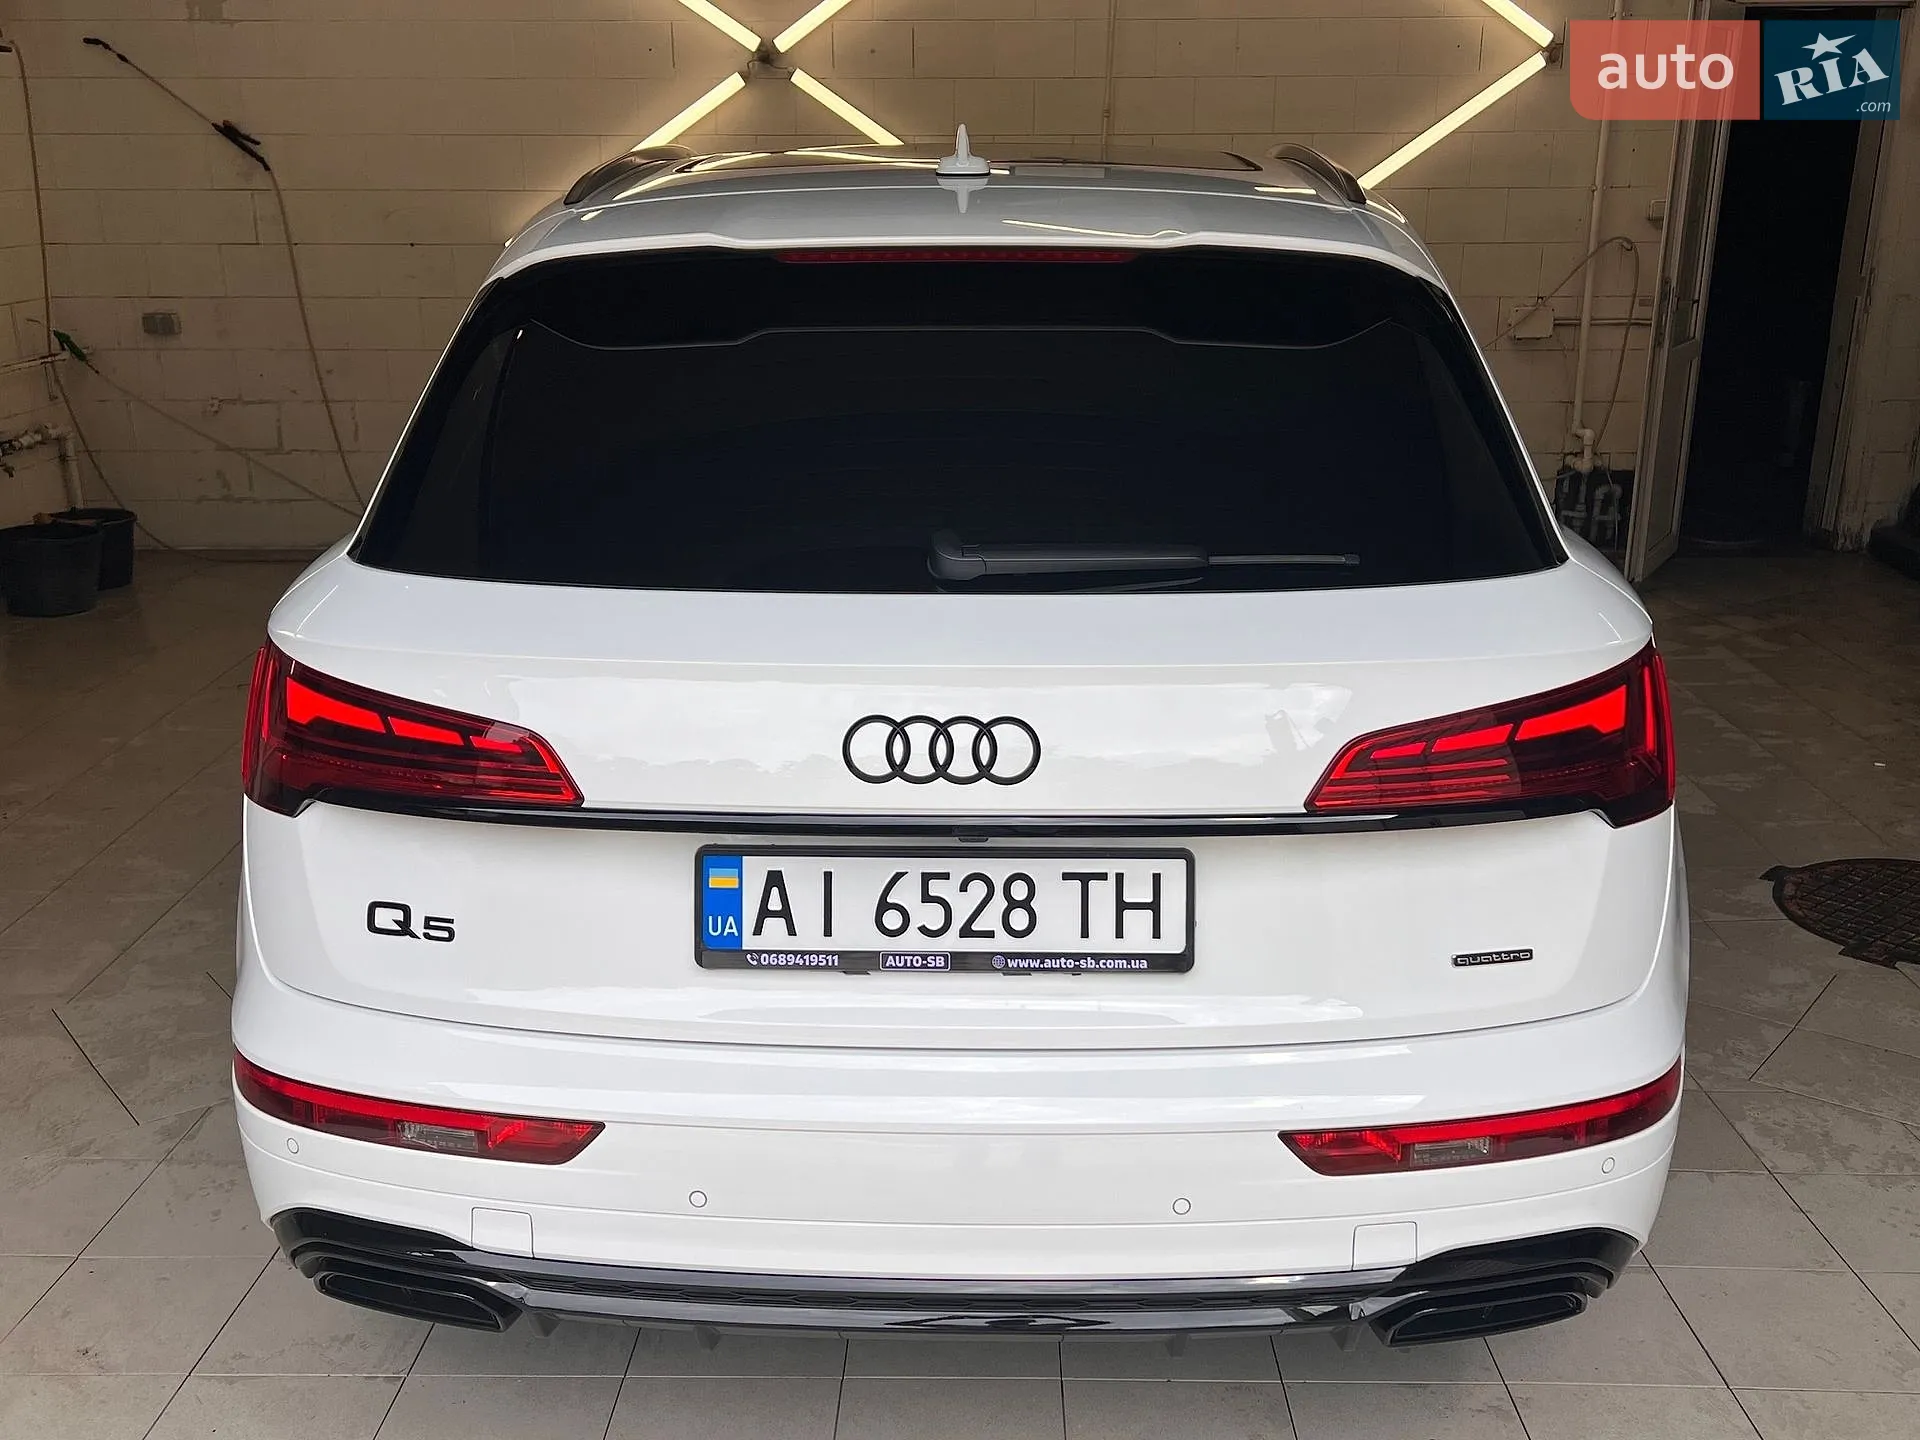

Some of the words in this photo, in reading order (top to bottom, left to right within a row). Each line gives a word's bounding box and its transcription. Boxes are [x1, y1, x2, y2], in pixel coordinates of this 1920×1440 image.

[752, 869, 833, 938] AI
[874, 871, 1037, 939] 6528
[1061, 872, 1162, 940] TH
[366, 900, 455, 942] Q5
[708, 915, 739, 937] UA
[760, 953, 840, 967] 0689419511
[886, 955, 945, 968] AUTO-SB
[1007, 955, 1149, 971] www.auto-sb.com.ua
[1456, 951, 1531, 966] quattro
